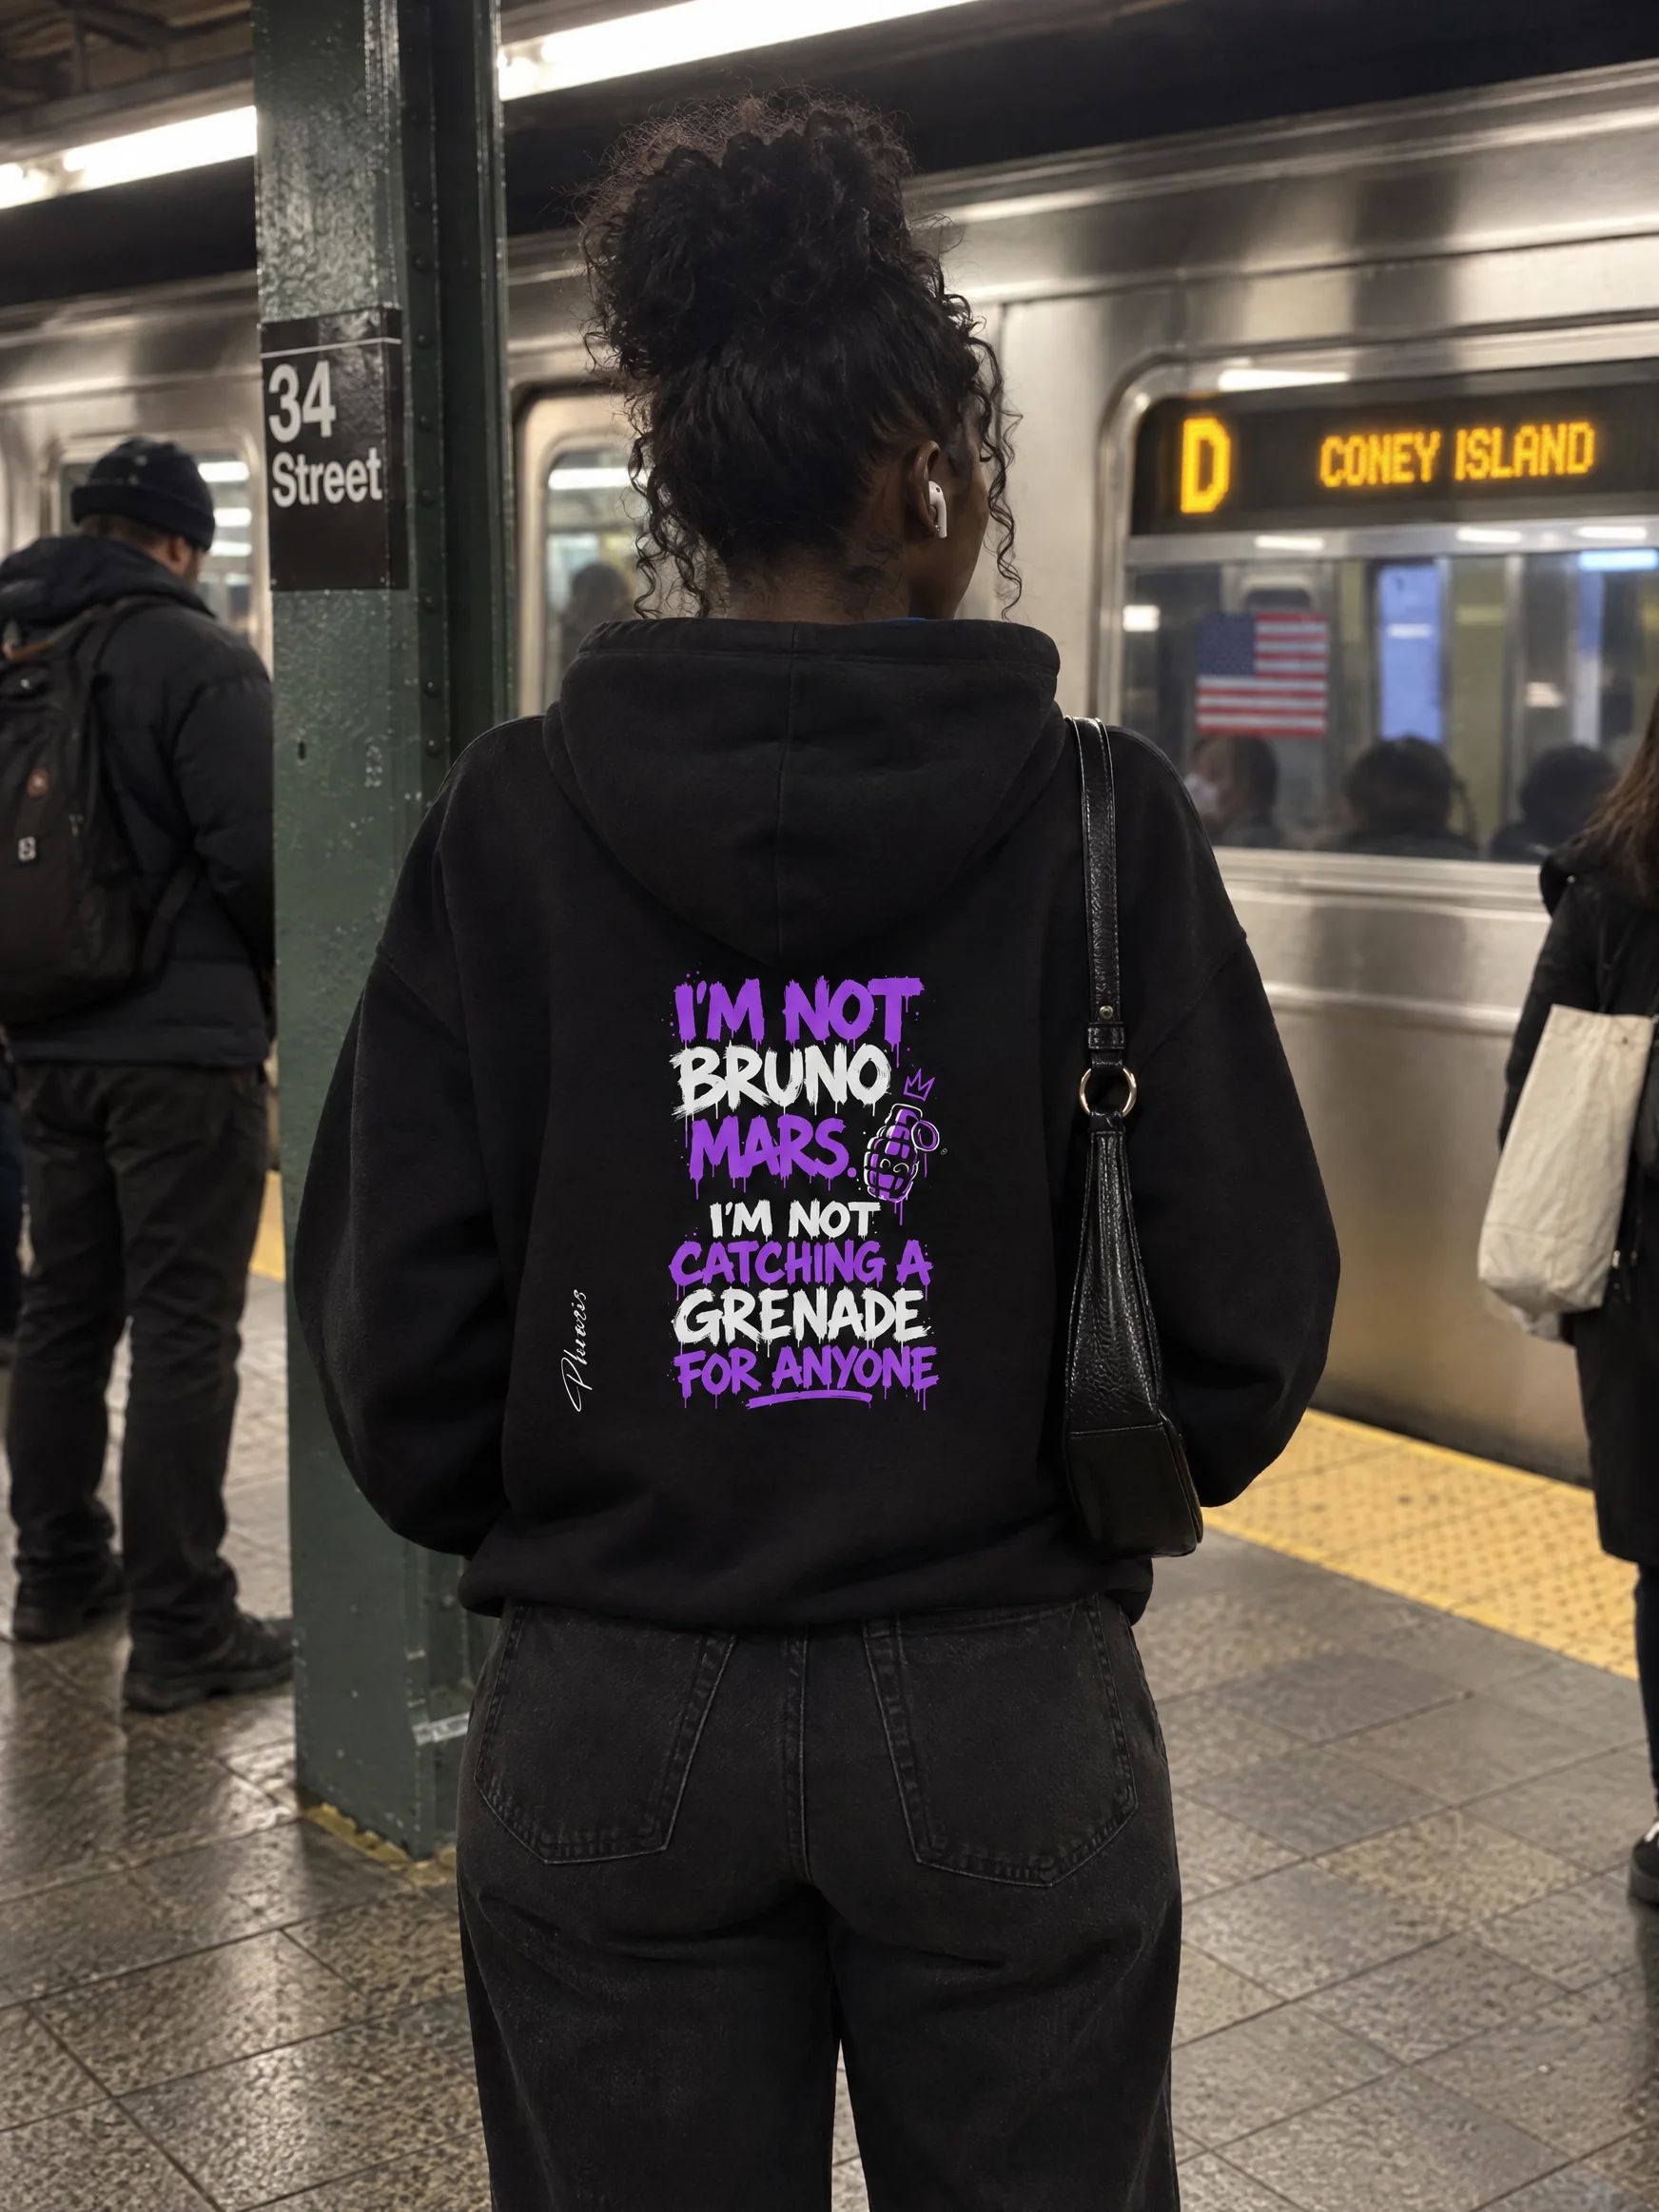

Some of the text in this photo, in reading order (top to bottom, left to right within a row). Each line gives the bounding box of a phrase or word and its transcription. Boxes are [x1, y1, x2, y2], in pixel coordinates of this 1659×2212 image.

[268, 361, 337, 442] 34
[272, 448, 382, 507] Street
[1181, 416, 1231, 514] D
[1320, 421, 1595, 487] CONEY ISLAND
[673, 976, 925, 1048] I'M NOT
[670, 1043, 891, 1115] BRUNO
[687, 1114, 857, 1185] MARS.
[710, 1198, 881, 1239] I'M NOT
[669, 1239, 933, 1287] CATCHING A
[672, 1285, 931, 1347] GRENADE
[673, 1345, 939, 1401] FOR ANYONE
